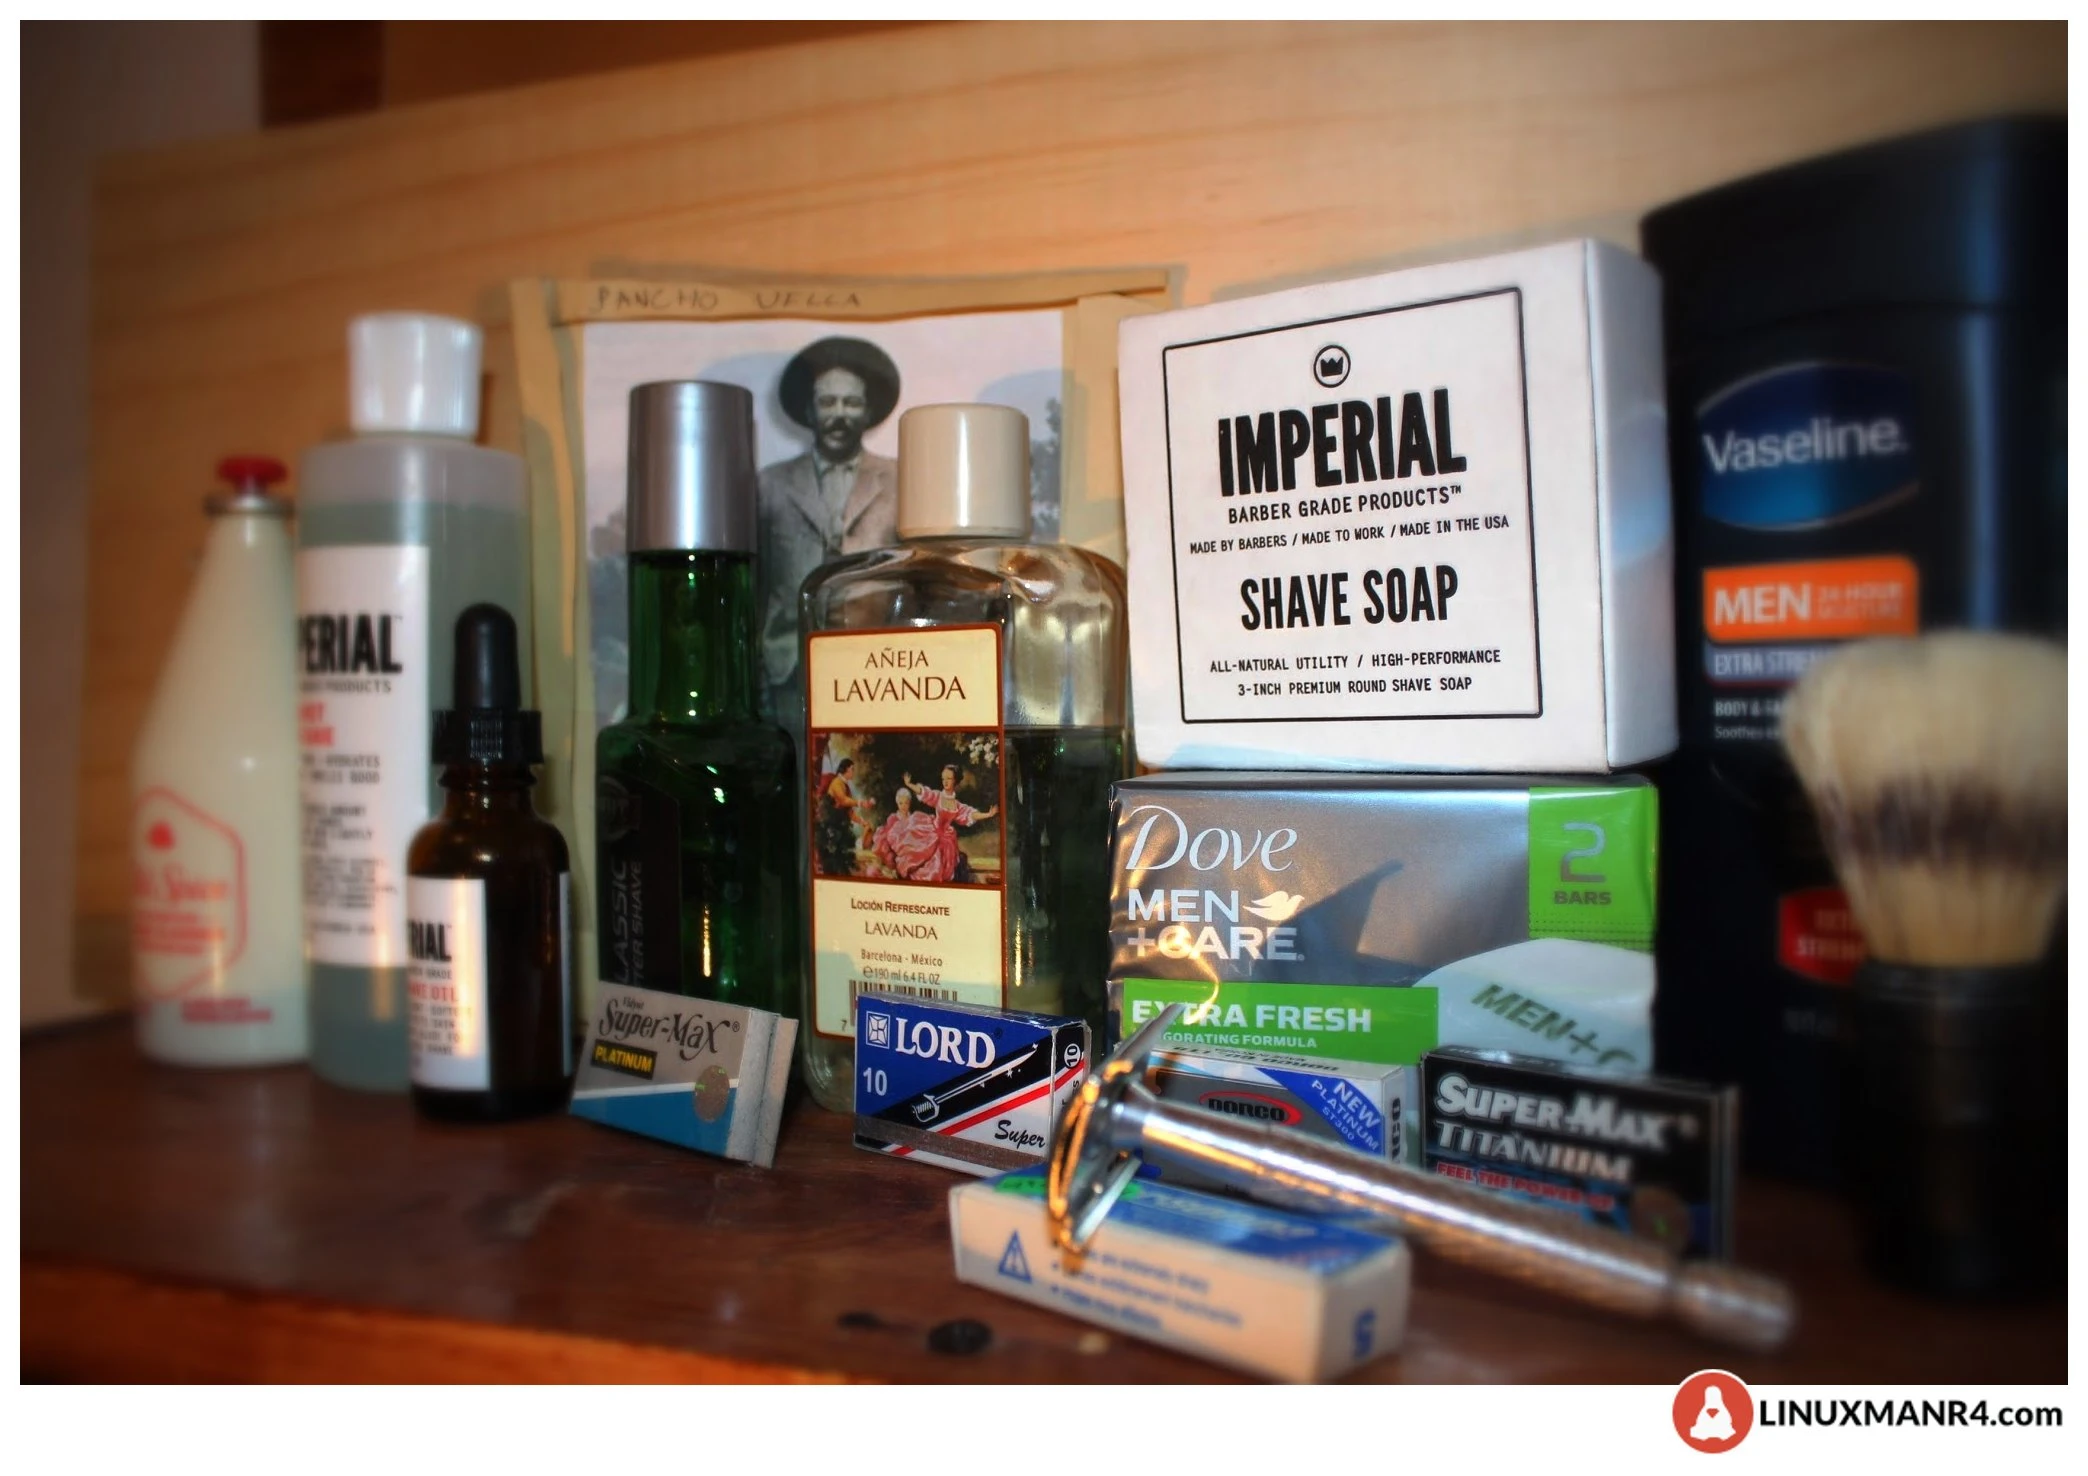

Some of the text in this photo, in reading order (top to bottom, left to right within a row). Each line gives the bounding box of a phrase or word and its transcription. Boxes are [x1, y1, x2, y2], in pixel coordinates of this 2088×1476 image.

[596, 286, 719, 311] PANCHO
[1217, 387, 1467, 498] IMPERIAL
[1228, 503, 1292, 525] BARBER
[1298, 496, 1353, 520] GRADE
[1189, 539, 1217, 555] MADE
[1220, 538, 1234, 553] BY
[1238, 533, 1288, 551] BARBERS
[1301, 530, 1332, 548] MADE
[1334, 527, 1350, 545] TO
[1354, 524, 1386, 542] WORK
[1400, 519, 1431, 538] MADE
[1436, 518, 1452, 535] IN
[1455, 516, 1481, 532] THE
[1484, 513, 1510, 530] USA
[1239, 564, 1459, 631] SHAVE SOAP
[1713, 581, 1814, 627] MEN
[864, 647, 929, 671] AÑEJA
[1209, 657, 1289, 674] ALL-NATURAL
[1295, 655, 1349, 671] UTILITY
[1371, 648, 1502, 668] HIGH-PERFORMANCE
[833, 675, 967, 703] LAVANDA
[1237, 675, 1473, 697] 3-INCH PREMIUM ROUND SHAVE SOAP
[1125, 804, 1298, 872] Dove
[1559, 821, 1606, 884] 2
[884, 901, 951, 917] REFRESCANTE
[1127, 889, 1240, 924] MEN
[1552, 889, 1612, 907] BARS
[610, 857, 630, 984] LASSIC
[864, 921, 939, 941] LAVANDA
[860, 948, 903, 964] Barcelona
[911, 953, 943, 967] México
[890, 968, 901, 981] ml
[902, 971, 916, 983] 6.4
[918, 972, 928, 985] FL
[929, 974, 942, 986] OZ
[840, 1019, 848, 1032] 7
[1255, 1003, 1373, 1034] FRESH
[894, 1016, 997, 1070] LORD
[1162, 1030, 1318, 1049] GORATING FORMULA
[594, 1044, 654, 1073] PLATINUM
[1065, 1045, 1080, 1068] 10
[862, 1066, 888, 1097] 10
[1311, 1079, 1380, 1151] PLATINUM
[1332, 1081, 1381, 1129] NEW
[993, 1119, 1046, 1150] Super
[1321, 1106, 1355, 1141] ST300
[1433, 1119, 1632, 1182] TITANIUM
[1436, 1161, 1473, 1182] FEEL
[1478, 1169, 1513, 1190] THE
